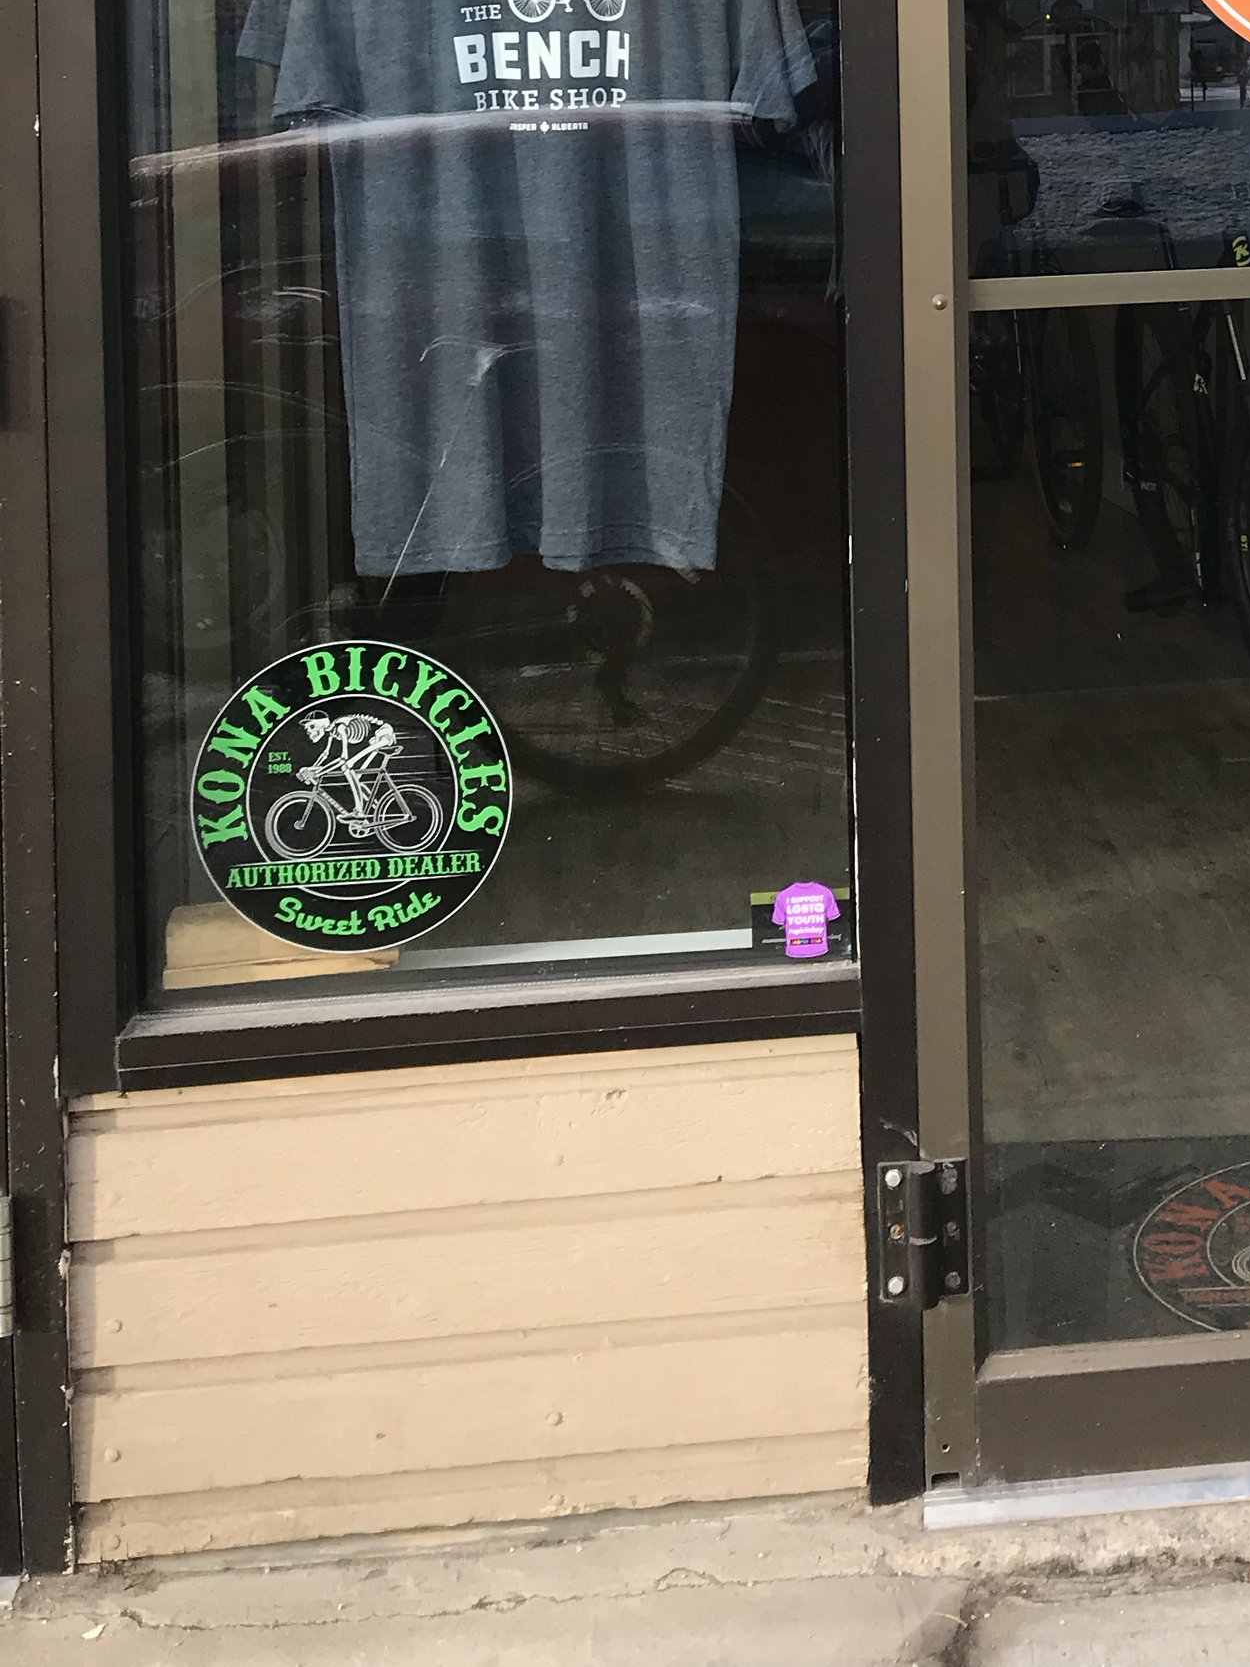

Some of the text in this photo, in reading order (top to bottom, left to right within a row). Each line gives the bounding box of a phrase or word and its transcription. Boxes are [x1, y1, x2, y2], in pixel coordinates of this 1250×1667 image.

[461, 4, 501, 22] THE
[453, 30, 630, 84] BENCH
[474, 88, 627, 112] BIKE SHOP
[509, 122, 588, 131] JASPER ALBERTA
[197, 647, 507, 849] KONA BICYCLES
[268, 751, 291, 762] EST.
[268, 763, 292, 774] 1988
[226, 852, 482, 889] AUTHORIZED DEALER
[791, 894, 824, 904] SUPPORT
[275, 891, 442, 936] Sweet Ride
[786, 903, 825, 914] LGBTQ
[787, 915, 824, 925] YOUTH
